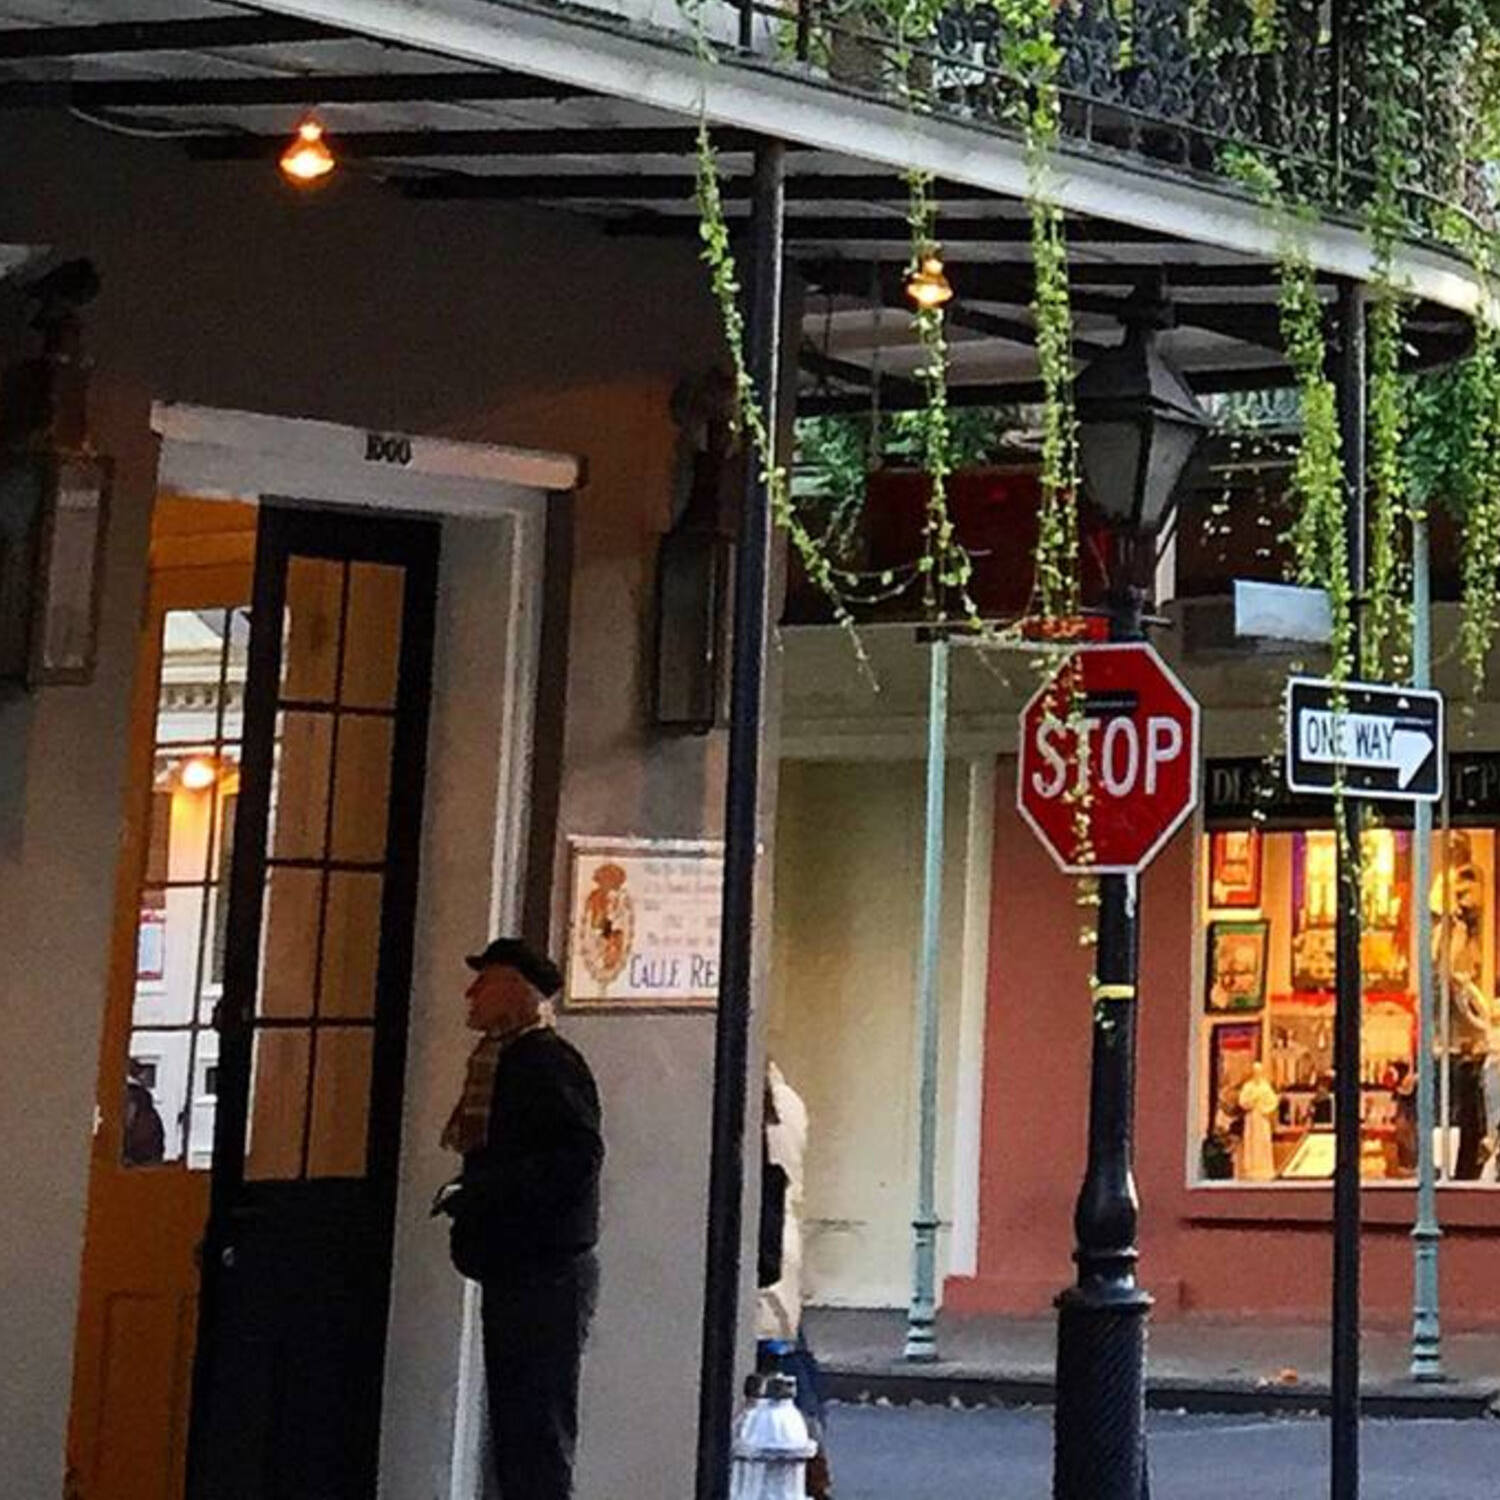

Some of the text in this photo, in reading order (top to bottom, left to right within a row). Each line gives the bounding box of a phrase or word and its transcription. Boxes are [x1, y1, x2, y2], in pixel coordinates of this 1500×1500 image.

[1032, 715, 1182, 799] STOP
[1307, 716, 1395, 760] ONE WAY
